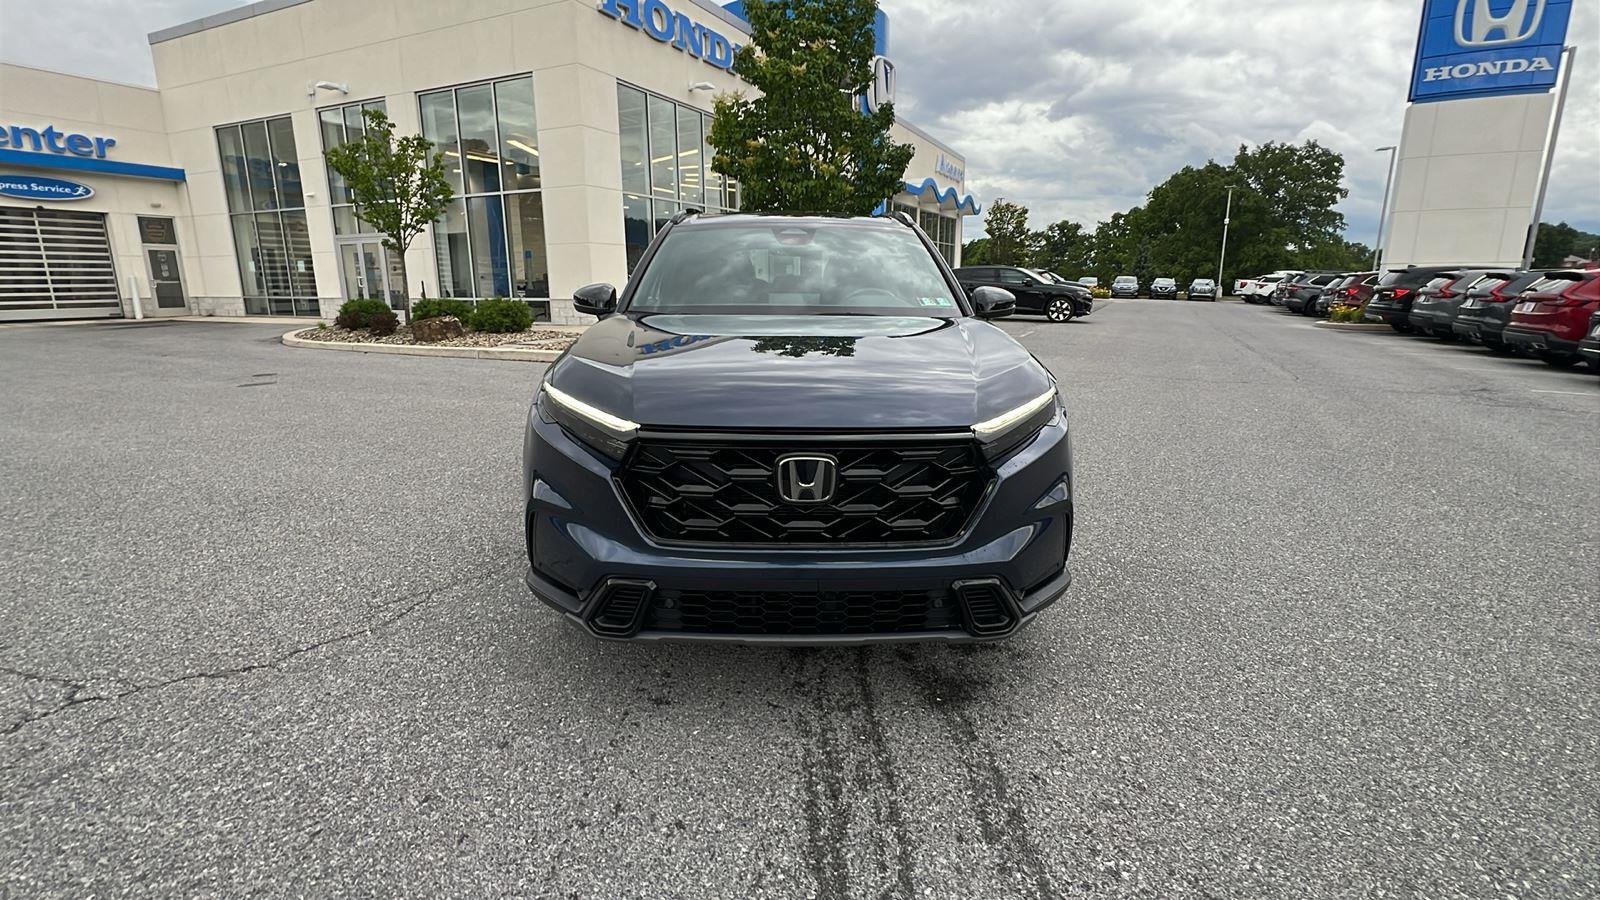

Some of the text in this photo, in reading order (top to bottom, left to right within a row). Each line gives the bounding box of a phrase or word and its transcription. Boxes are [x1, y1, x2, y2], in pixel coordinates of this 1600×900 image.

[598, 0, 745, 77] HOND
[1423, 57, 1553, 82] HONDA
[30, 183, 72, 194] Service
